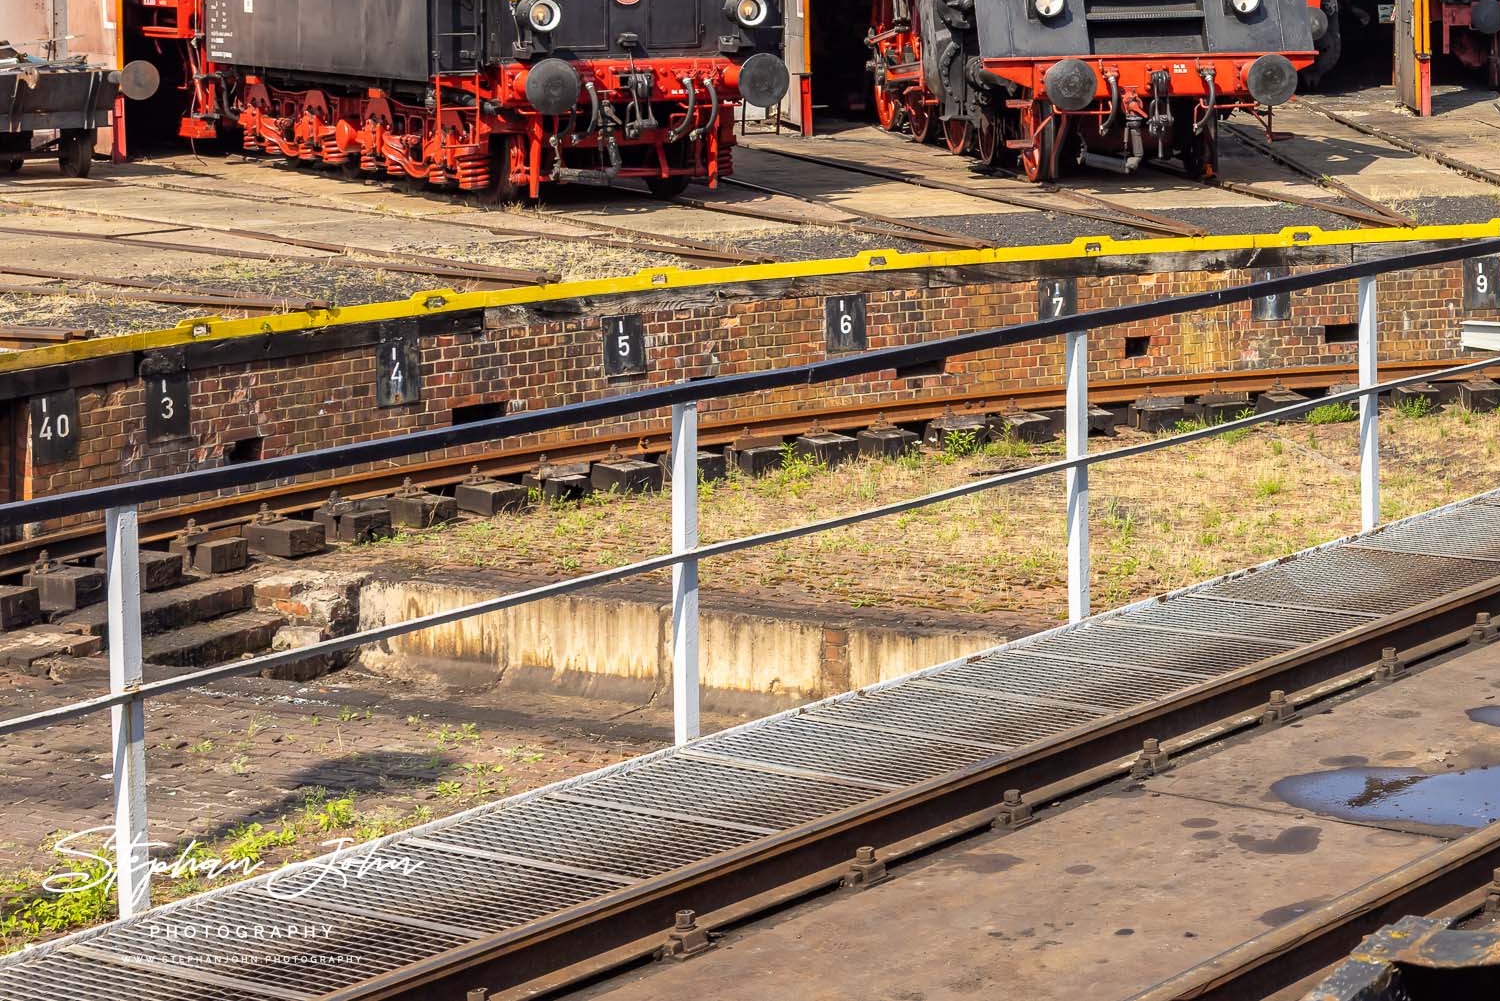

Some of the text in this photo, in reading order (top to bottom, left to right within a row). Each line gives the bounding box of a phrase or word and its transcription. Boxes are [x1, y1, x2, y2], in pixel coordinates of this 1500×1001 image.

[1476, 274, 1488, 293] 9
[1052, 296, 1063, 317] 7
[840, 314, 852, 334] 6
[618, 335, 630, 356] 5
[391, 361, 402, 382] 4
[161, 396, 174, 419] 3
[39, 413, 70, 440] 40
